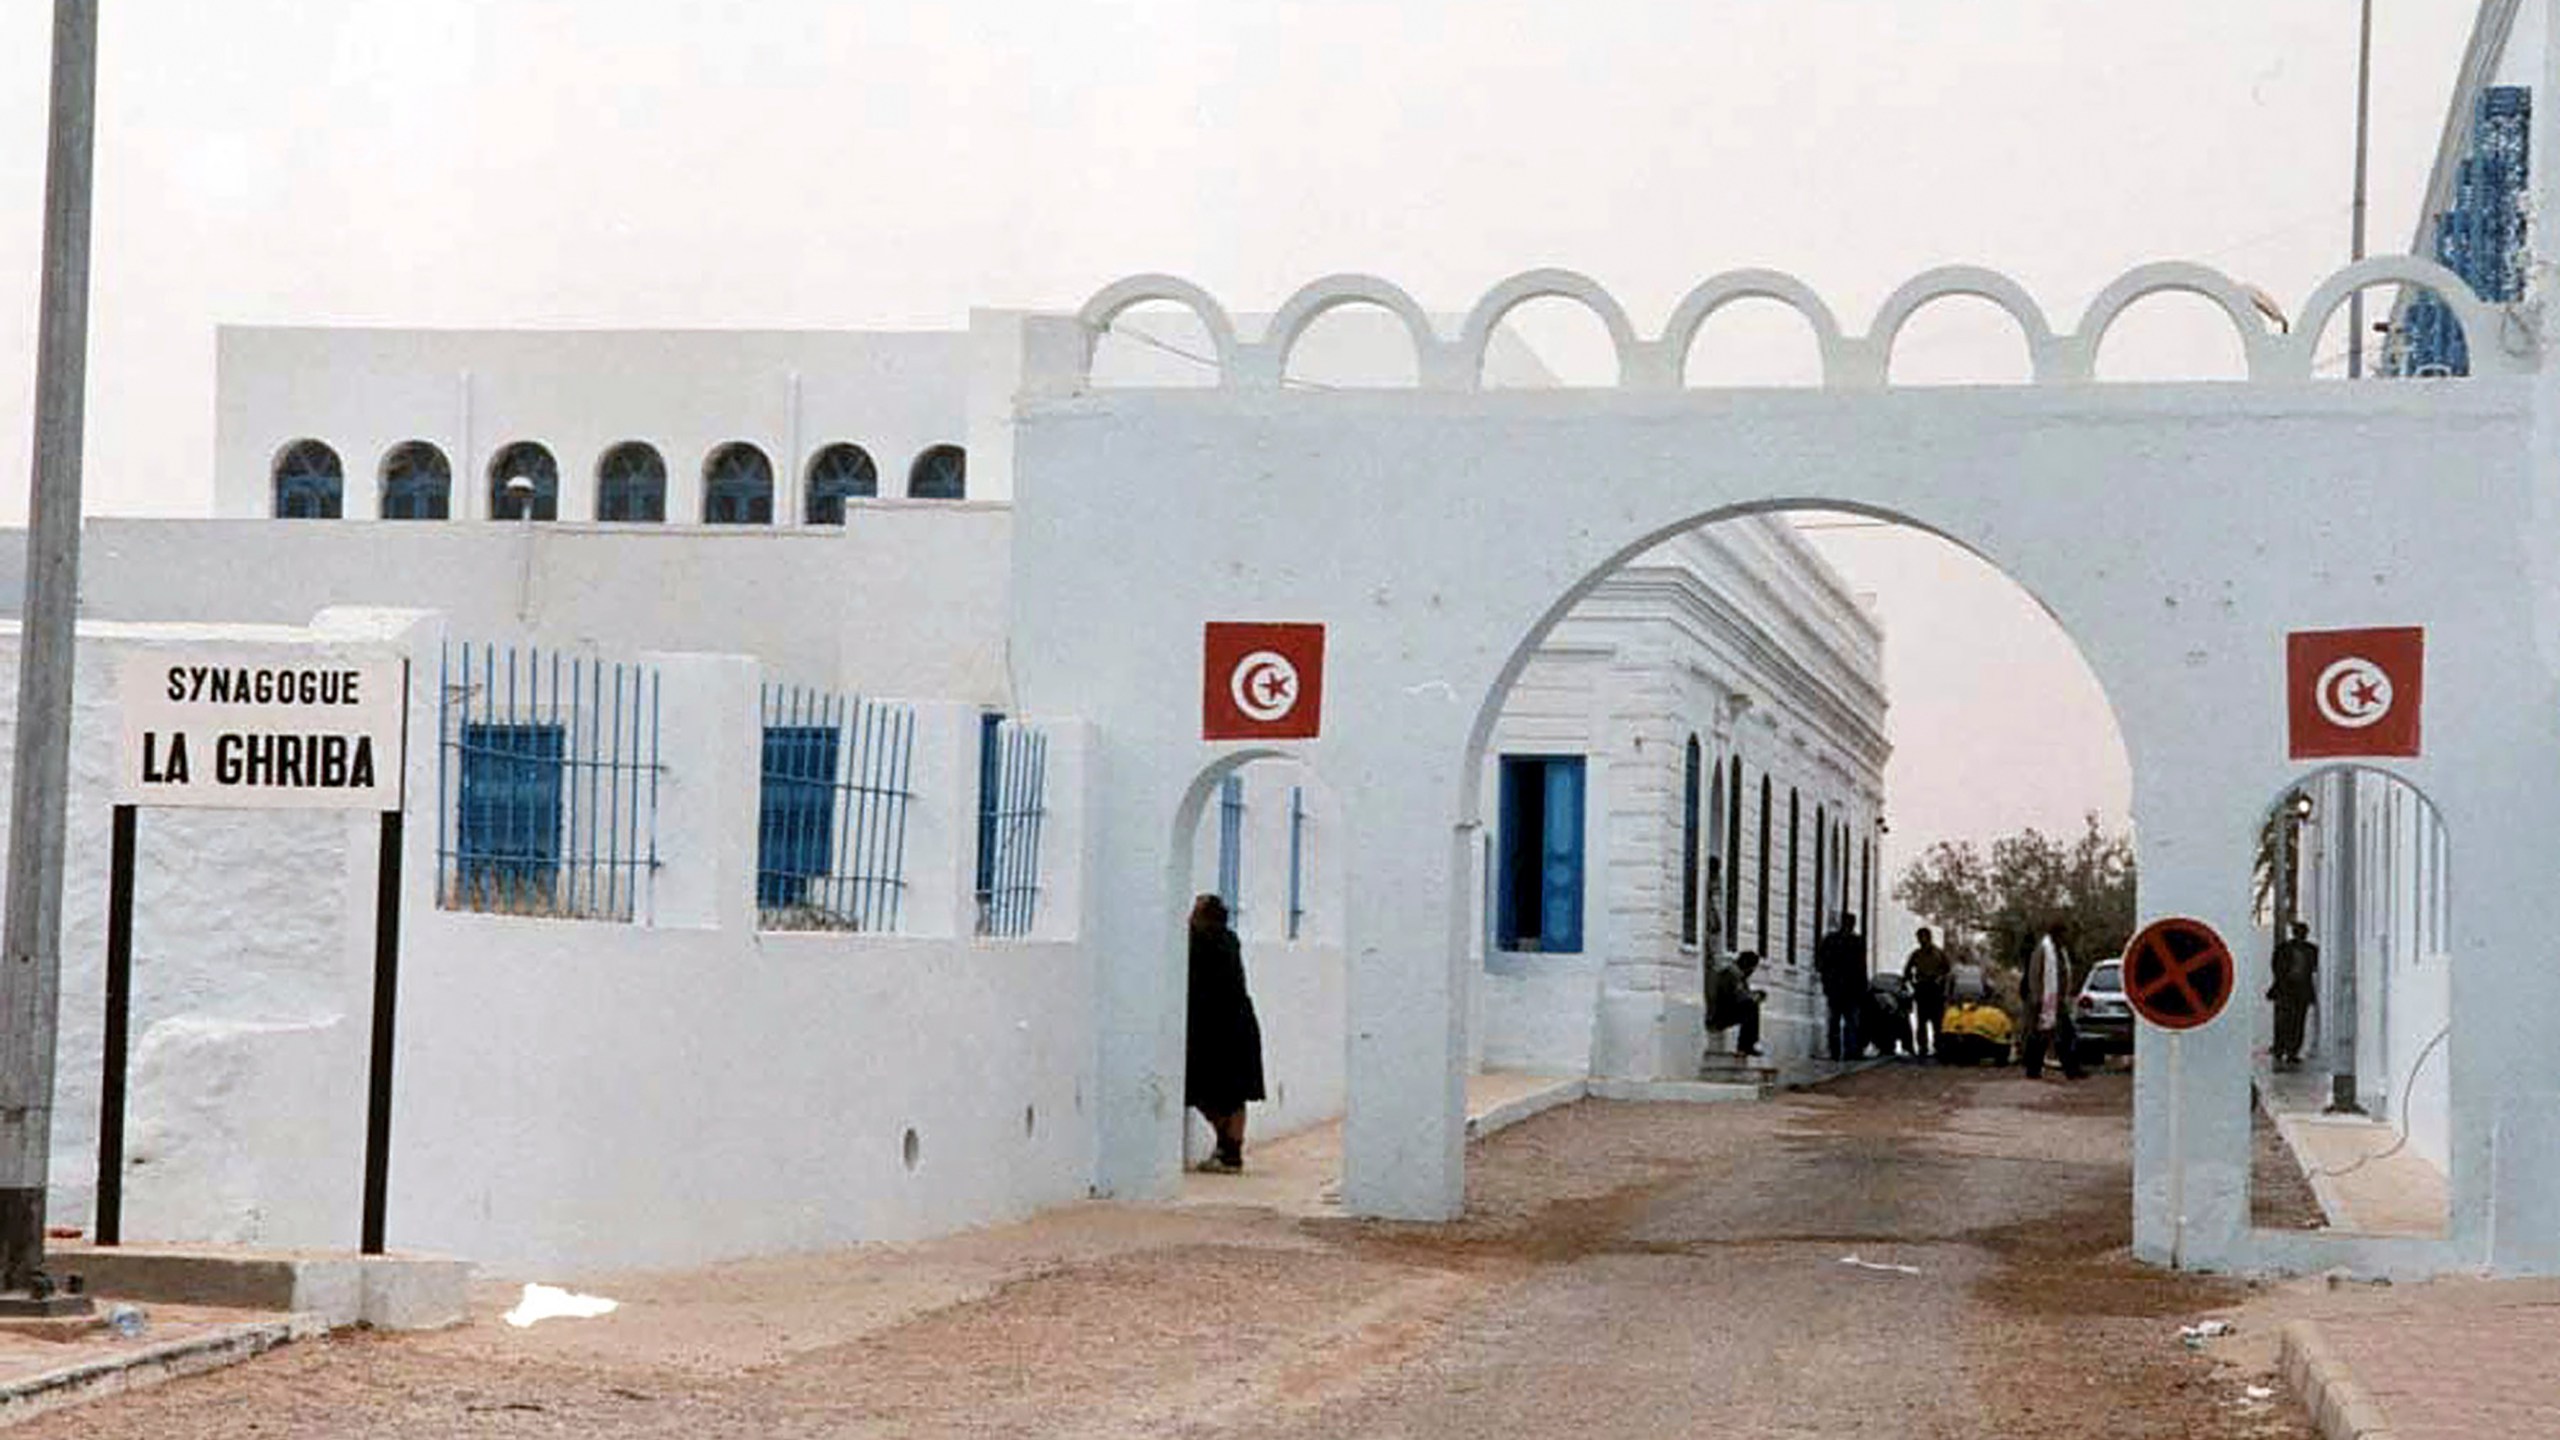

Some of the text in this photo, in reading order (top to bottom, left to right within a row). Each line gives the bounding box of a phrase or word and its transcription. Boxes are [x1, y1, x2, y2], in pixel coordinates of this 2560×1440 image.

[168, 667, 360, 704] SYNAGOGUE
[143, 732, 375, 787] LA GHRIBA
